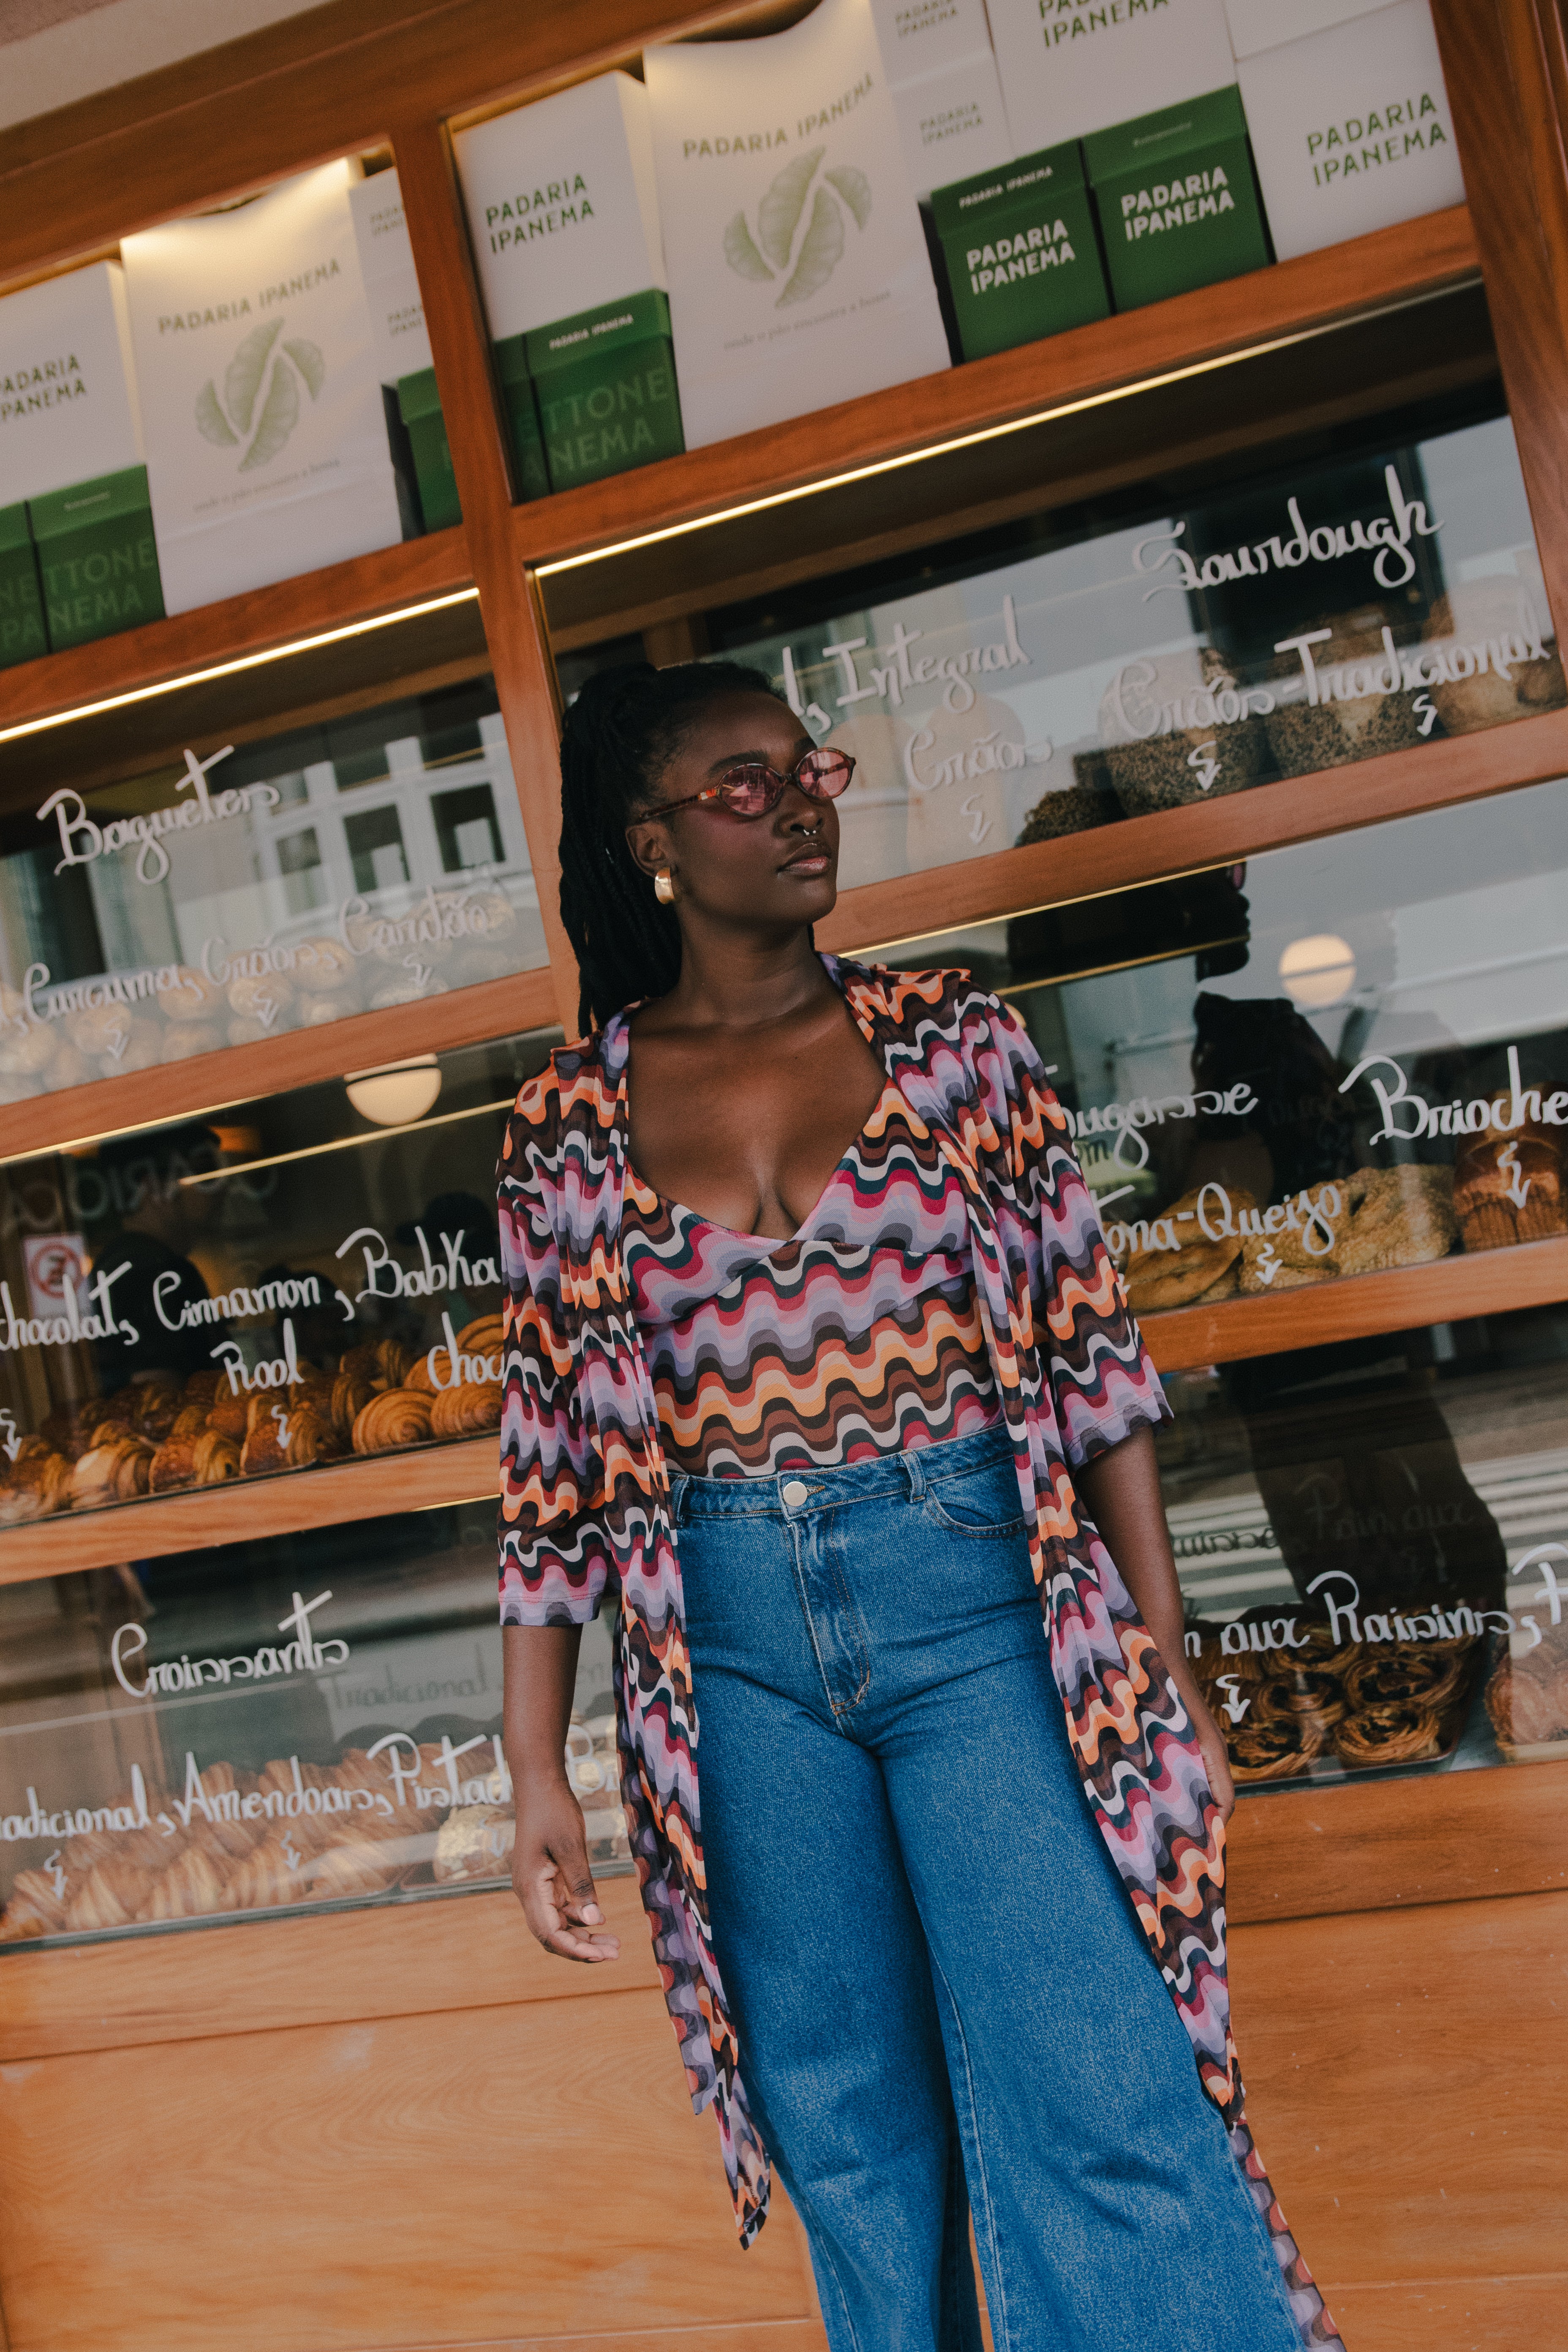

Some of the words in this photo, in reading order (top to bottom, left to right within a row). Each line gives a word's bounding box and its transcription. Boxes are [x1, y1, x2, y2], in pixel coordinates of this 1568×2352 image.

[683, 127, 788, 158] PADARIA
[1307, 93, 1437, 156] PADARIA
[1313, 122, 1447, 186] IPANEMA
[485, 172, 586, 228] PADARIA
[1120, 165, 1229, 218] PADARIA
[1125, 189, 1235, 242] IPANEMA
[490, 199, 593, 255] IPANEMA
[966, 219, 1069, 272] PADARIA
[971, 240, 1076, 295] IPANEMA
[158, 297, 251, 336] PADARIA
[0, 354, 81, 394] ADARIA
[1132, 464, 1445, 602] Sourdough
[822, 594, 1032, 713] Integral
[1338, 1045, 1568, 1146] Brioche
[111, 1590, 350, 1698] Croissants
[0, 1763, 177, 1841] adicional,
